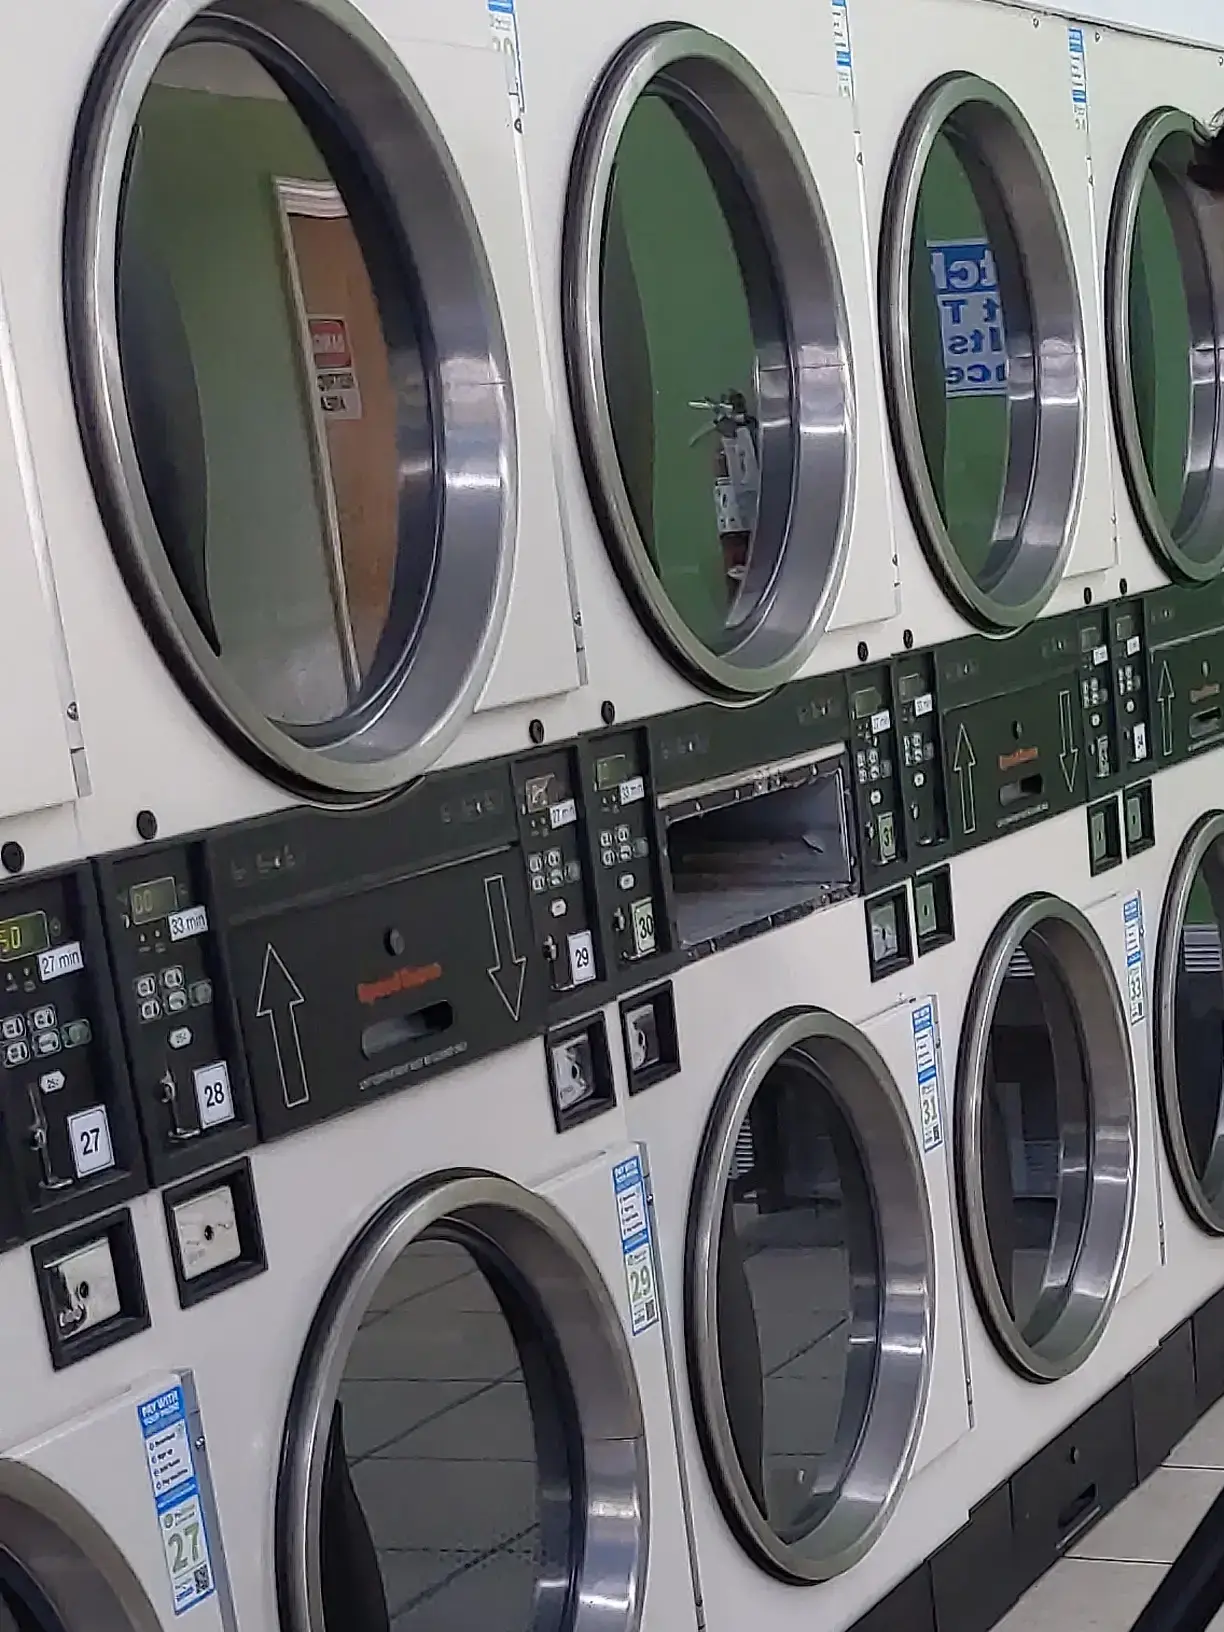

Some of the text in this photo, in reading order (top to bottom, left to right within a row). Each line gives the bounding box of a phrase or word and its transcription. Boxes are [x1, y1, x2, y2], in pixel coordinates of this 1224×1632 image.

[171, 914, 206, 935] 33 min
[639, 914, 653, 939] 30
[41, 950, 80, 975] 27 min
[575, 947, 589, 968] 29
[204, 1082, 224, 1108] 28
[80, 1127, 100, 1156] 27
[630, 1266, 651, 1301] 29
[167, 1522, 199, 1573] 27
